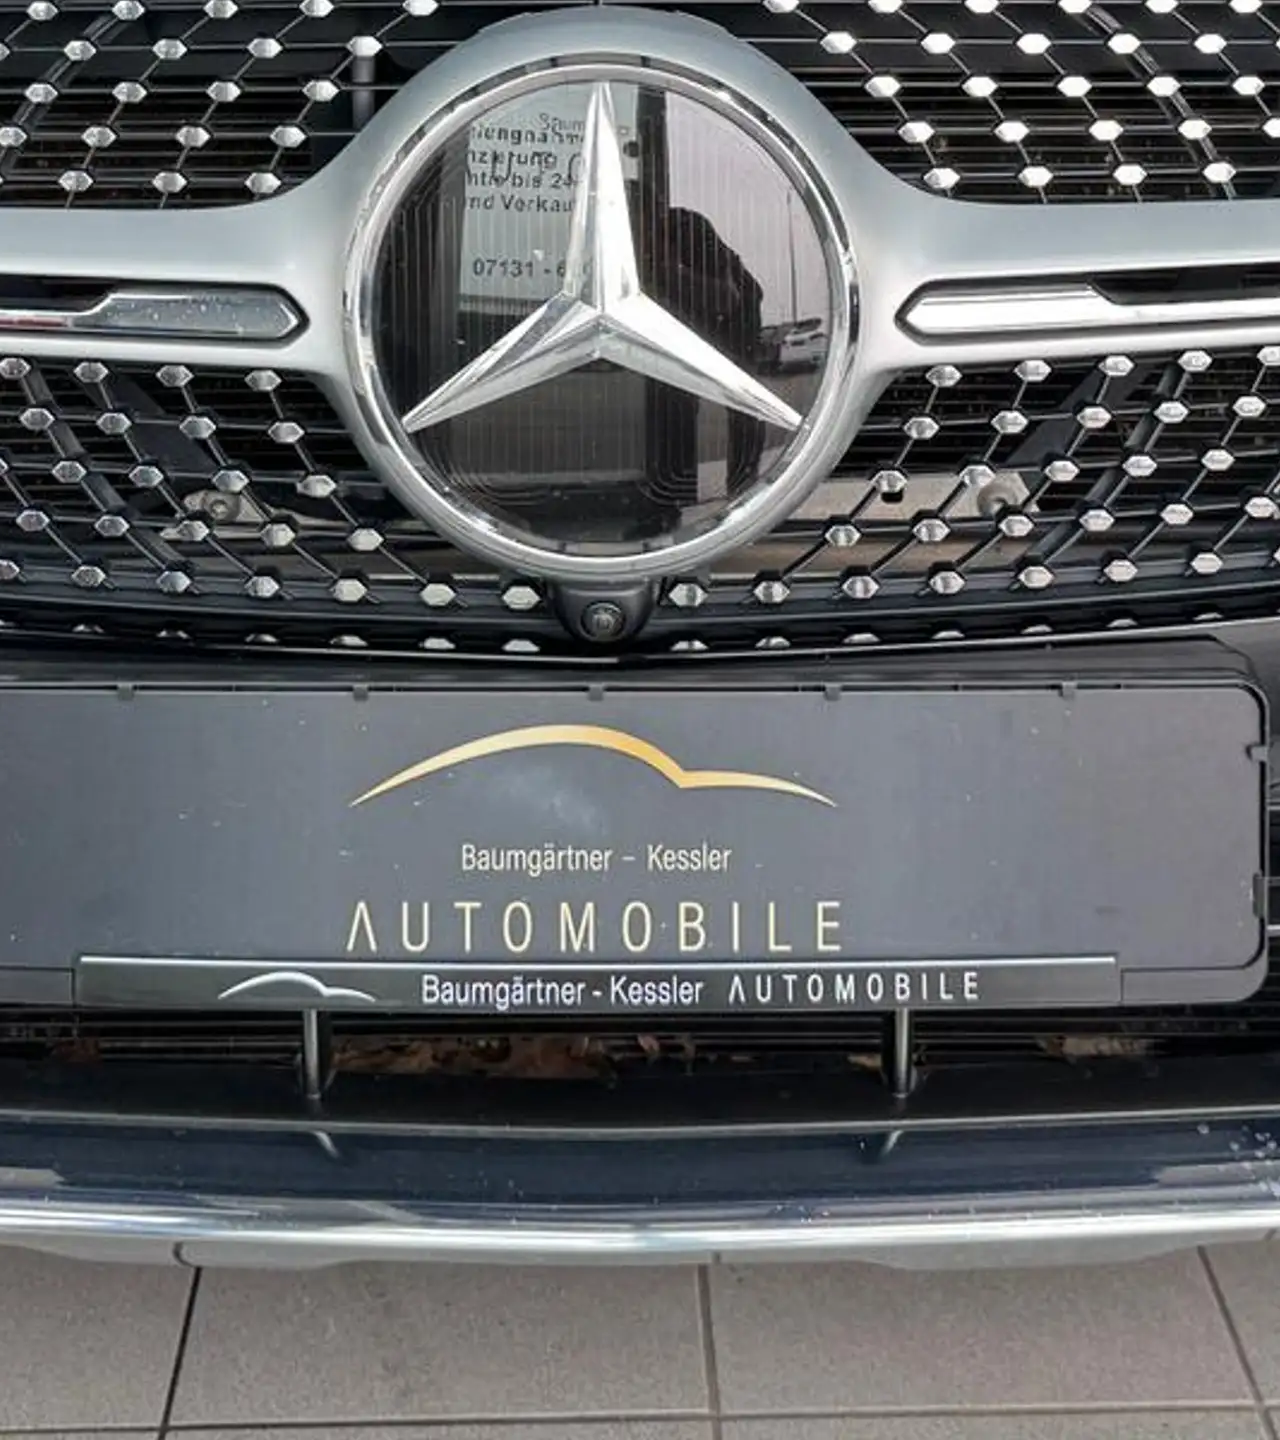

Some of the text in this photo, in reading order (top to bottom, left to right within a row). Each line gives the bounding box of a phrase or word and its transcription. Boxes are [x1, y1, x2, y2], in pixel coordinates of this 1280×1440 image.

[461, 842, 612, 878] Baumgärtner
[647, 842, 733, 872] Kessler
[346, 900, 843, 953] AUTOMOBILE
[421, 973, 587, 1012] Baumgärtner
[609, 974, 706, 1006] Kessler
[727, 970, 980, 1005] AUTOMOBILE
